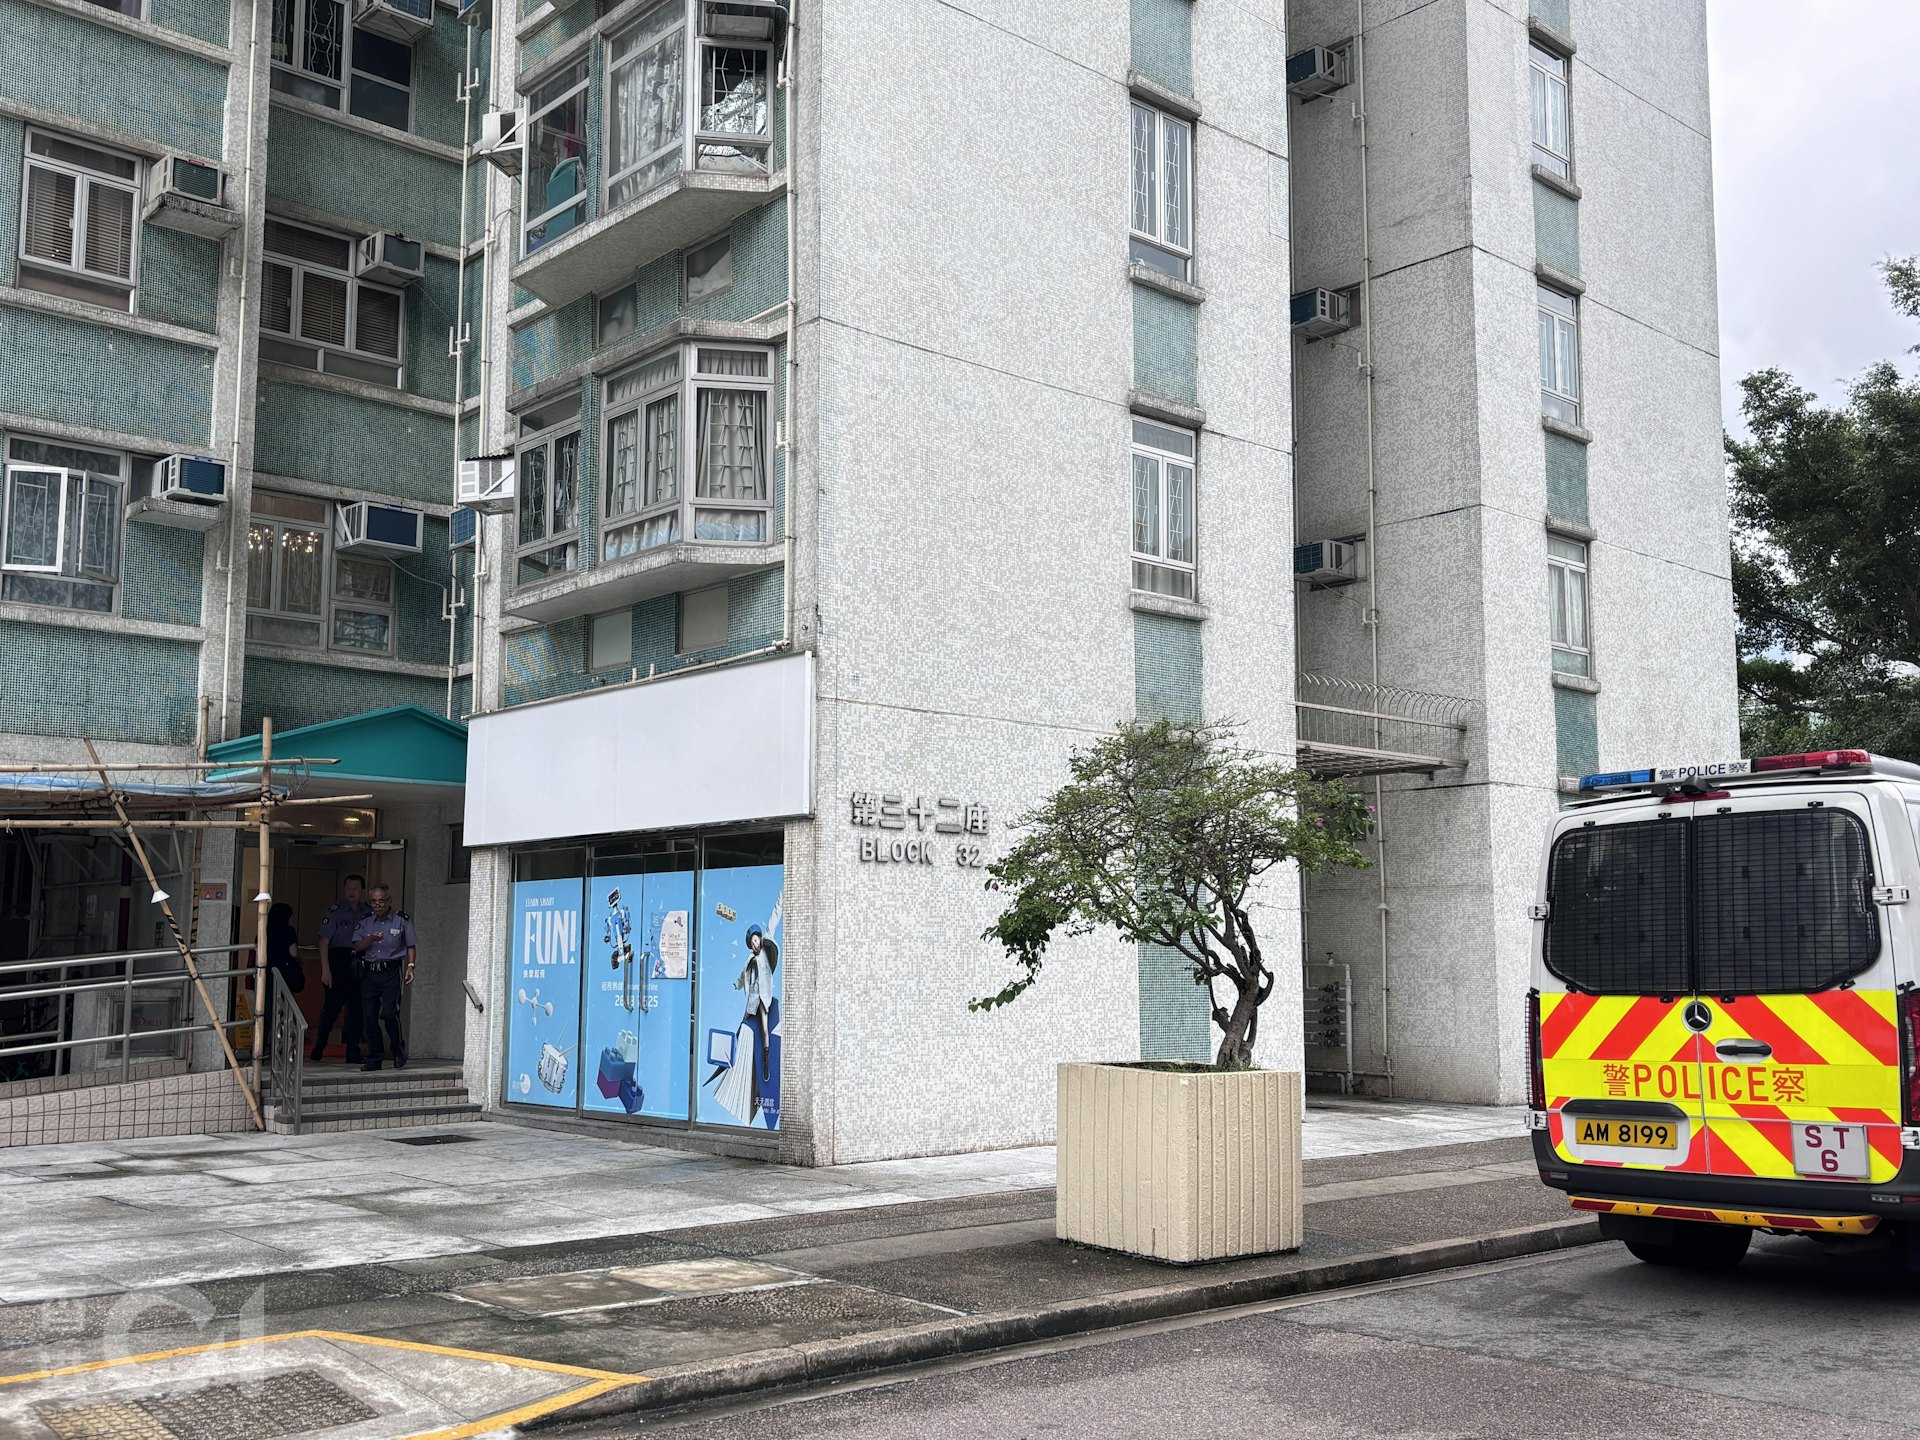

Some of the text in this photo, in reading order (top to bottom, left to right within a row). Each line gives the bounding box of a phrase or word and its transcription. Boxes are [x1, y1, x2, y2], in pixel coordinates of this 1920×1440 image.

[851, 791, 990, 835] 第三十二座
[860, 837, 983, 868] BLOCK 32
[1603, 1062, 1806, 1103] 警POLICE察
[1583, 1122, 1668, 1145] AM 8199
[1820, 1149, 1839, 1172] 6
